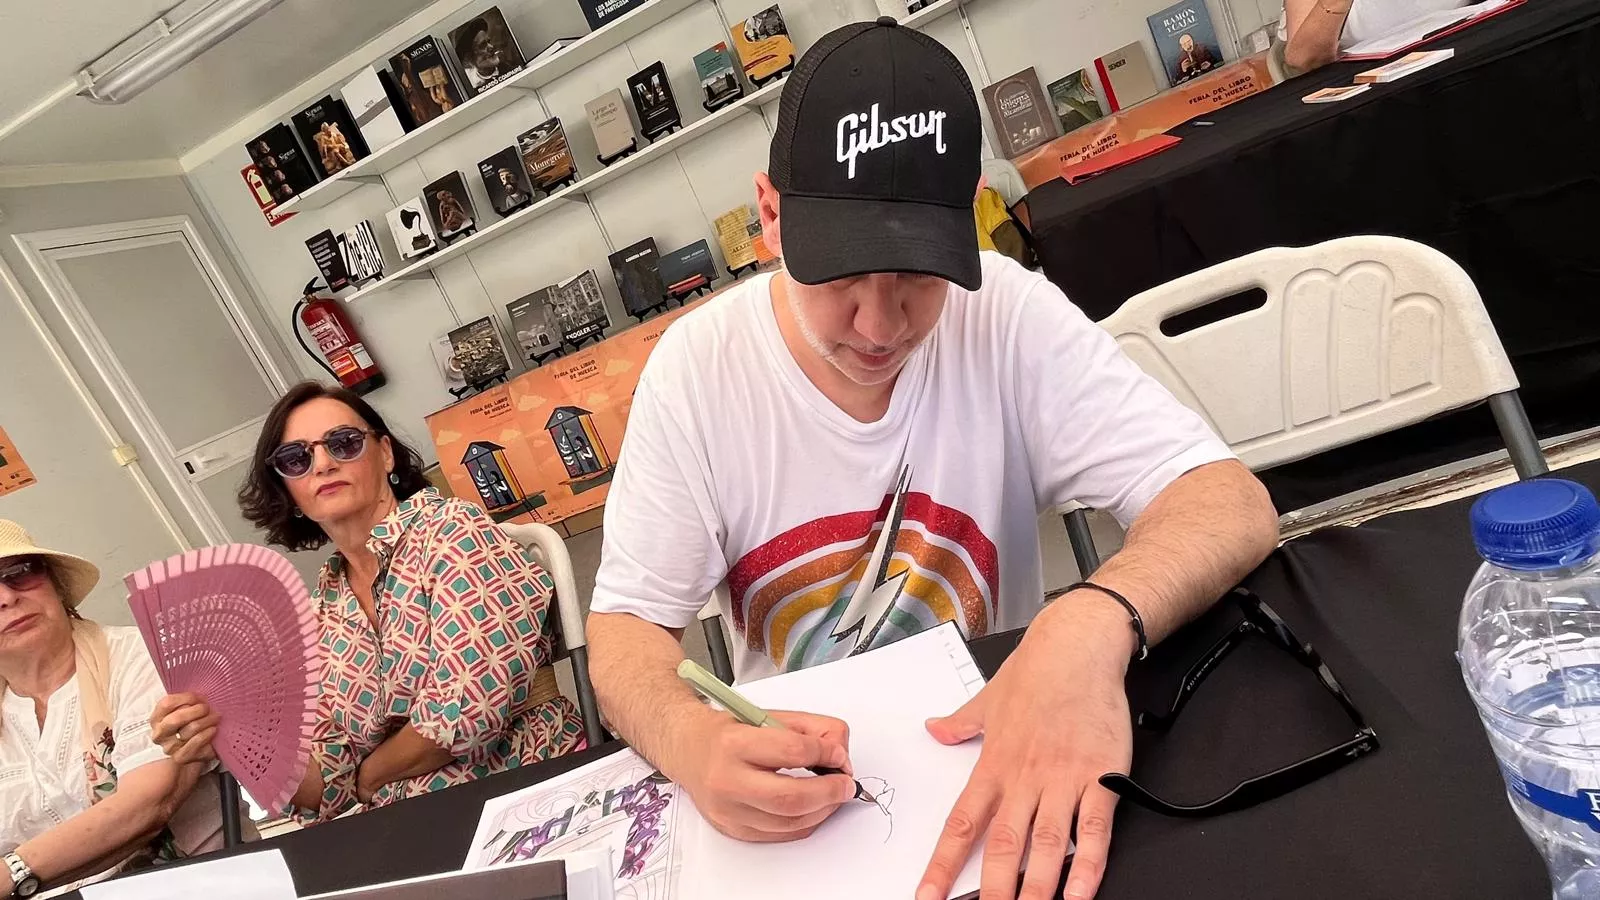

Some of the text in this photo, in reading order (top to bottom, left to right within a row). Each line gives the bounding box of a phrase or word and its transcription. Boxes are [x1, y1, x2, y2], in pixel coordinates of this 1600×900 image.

[597, 11, 606, 19] DE
[1163, 8, 1195, 27] RAMÓN
[1171, 15, 1196, 31] CAJAL
[410, 42, 433, 58] SIGNOS
[1107, 58, 1127, 71] SENDER
[477, 77, 499, 94] RICARDO
[1188, 93, 1210, 105] FERIA
[1212, 86, 1226, 97] DEL
[1228, 75, 1251, 91] LIBRO
[1212, 96, 1223, 104] DE
[1224, 82, 1254, 99] HUESCA
[836, 102, 947, 180] Gibson
[1059, 133, 1117, 163] FERIA DEL LIBRO
[1081, 139, 1120, 162] DE HUESCA
[529, 151, 566, 172] Monegros
[553, 371, 569, 380] FERIA
[569, 366, 580, 375] DEL
[580, 360, 596, 371] LIBRO
[578, 366, 598, 378] HUESCA
[470, 407, 484, 416] FERIA
[484, 402, 493, 411] DEL
[493, 396, 508, 407] LIBRO
[483, 409, 491, 417] DE
[491, 403, 510, 415] HUESCA
